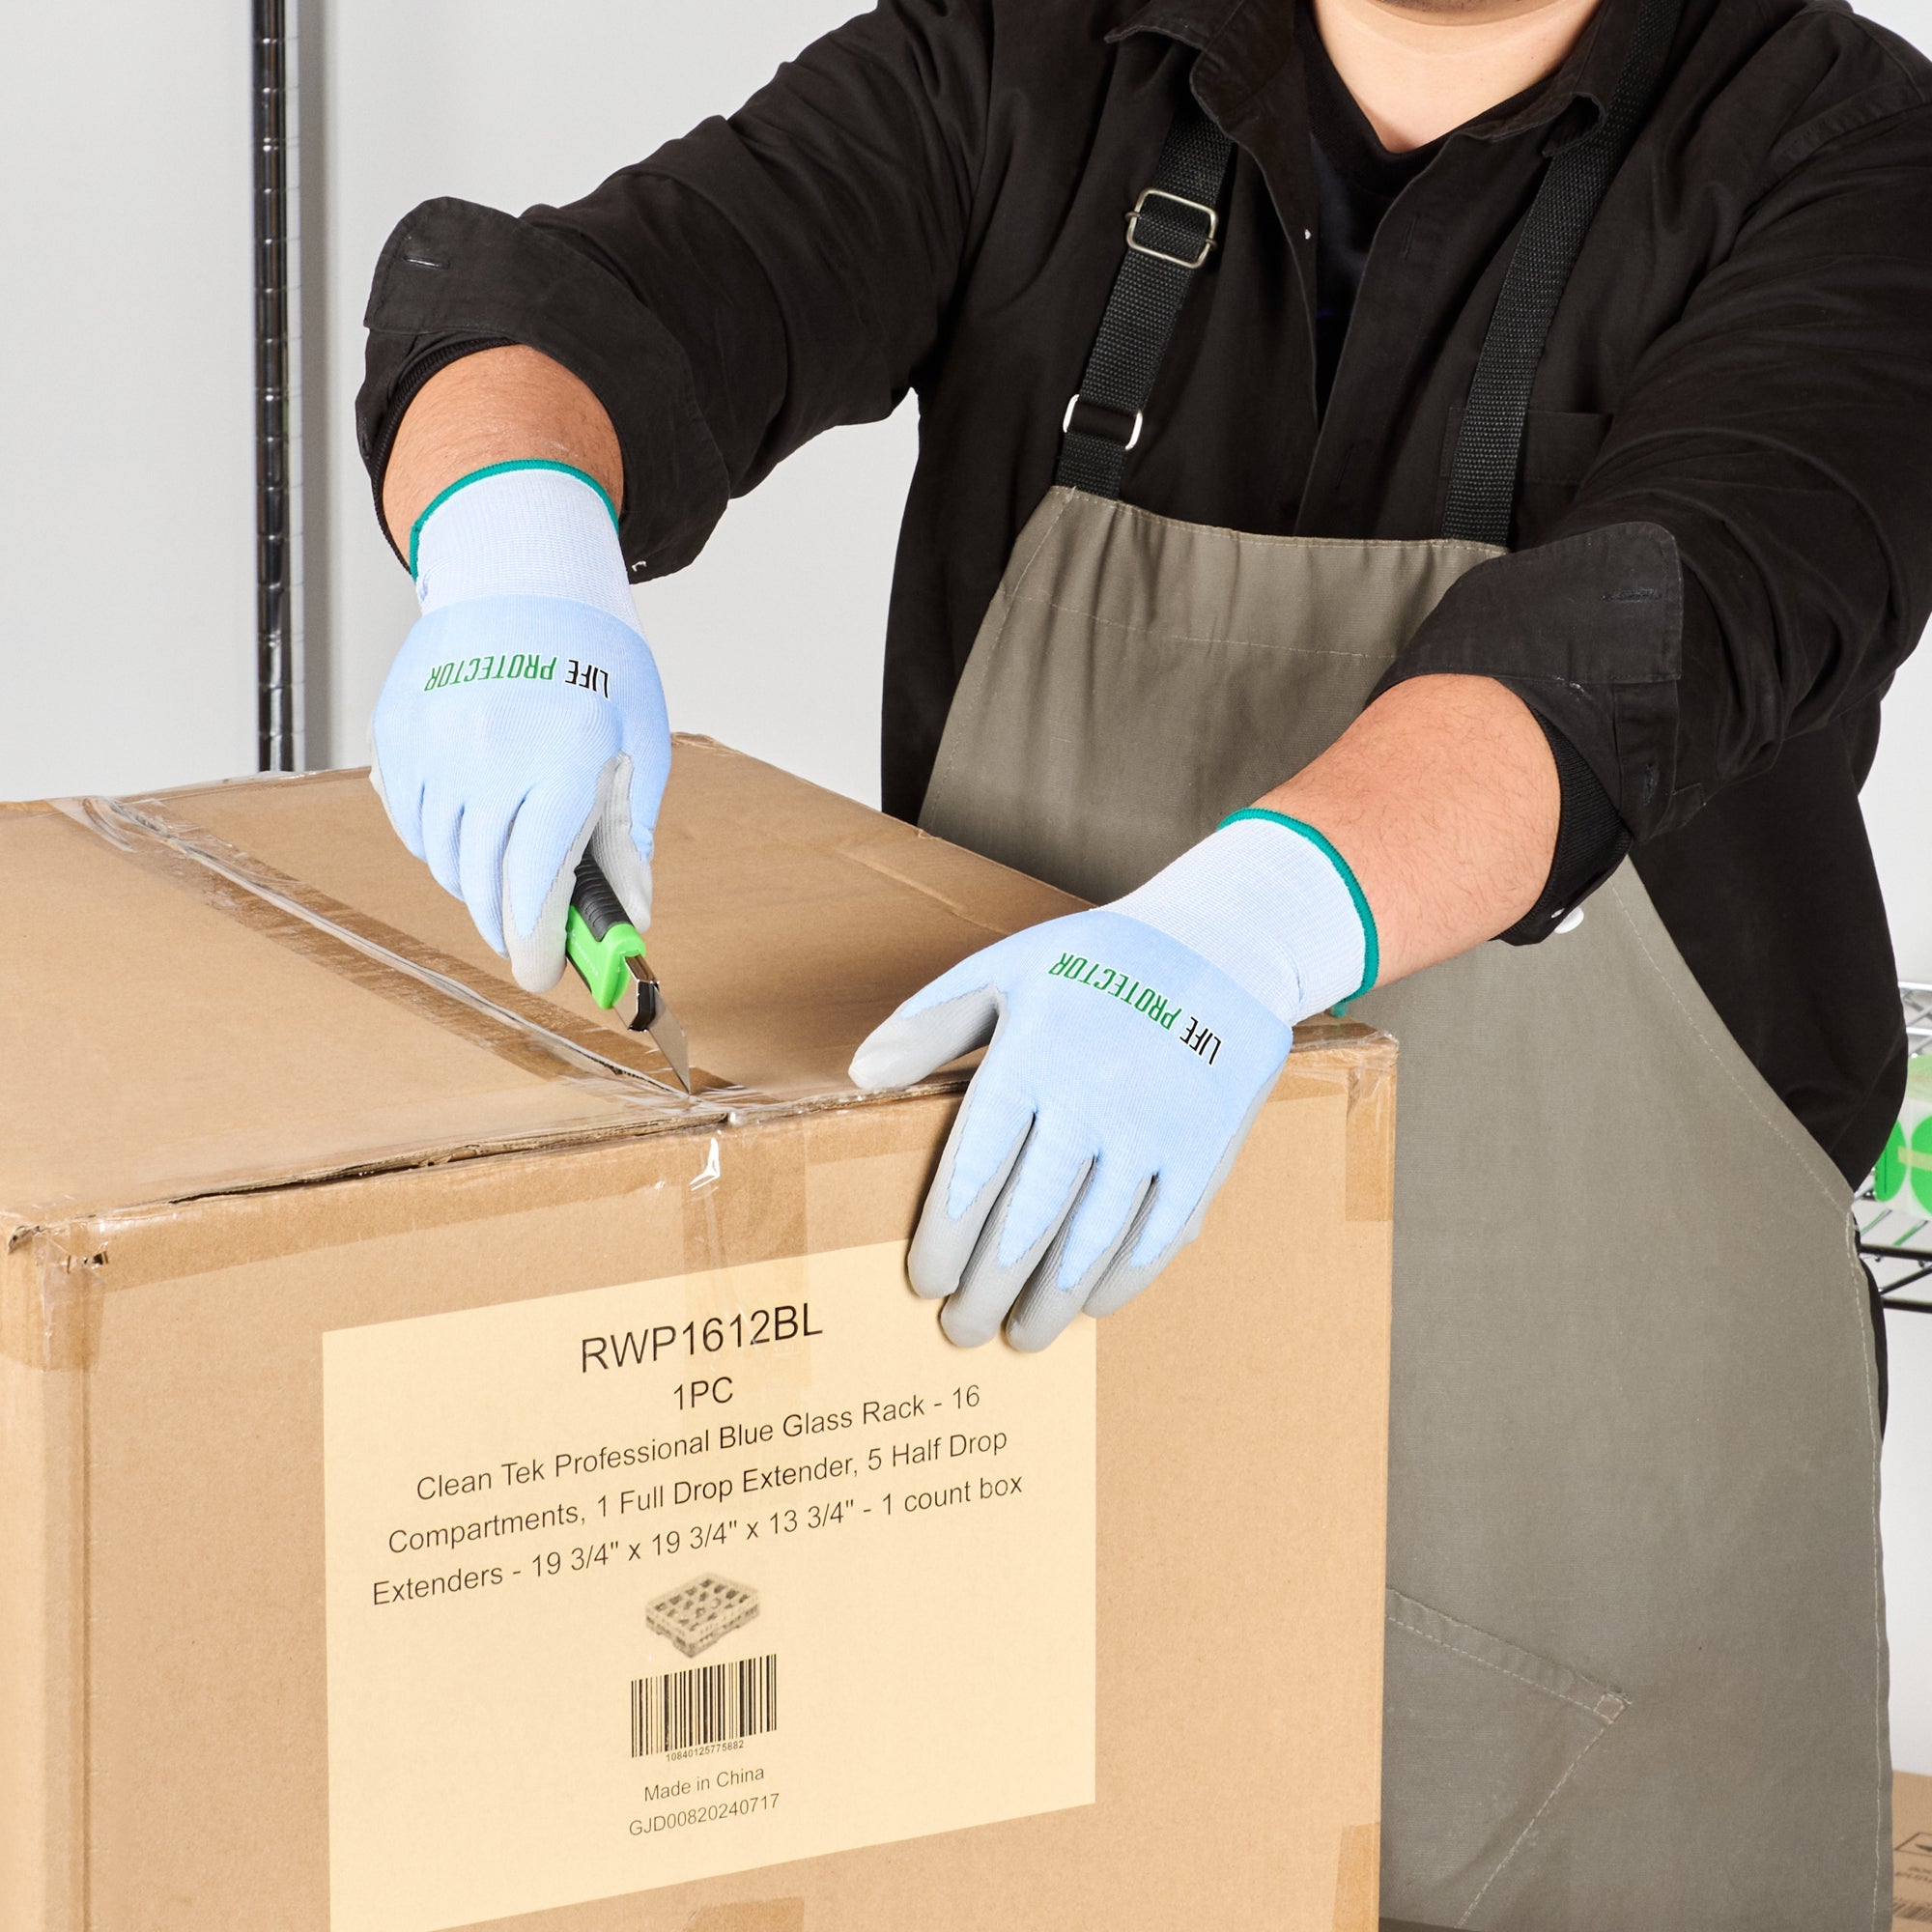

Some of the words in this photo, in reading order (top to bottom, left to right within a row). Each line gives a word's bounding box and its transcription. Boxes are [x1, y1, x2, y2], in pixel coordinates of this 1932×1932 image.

[424, 654, 557, 692] PROTECTOR
[565, 660, 609, 698] LIFE
[1048, 952, 1182, 1030] PROTECTOR
[1179, 1016, 1222, 1065] LIFE
[582, 1303, 823, 1373] RWP1612BL
[673, 1377, 733, 1410] 1PC
[417, 1472, 492, 1500] Clean
[501, 1459, 545, 1486] Tek
[555, 1430, 708, 1477] Professional
[721, 1423, 773, 1449] Blue
[783, 1411, 853, 1437] Glass
[863, 1395, 924, 1425] Rack
[952, 1384, 980, 1409] 16
[389, 1504, 585, 1553] Compartments,
[597, 1495, 606, 1518] 1
[620, 1486, 664, 1515] Full
[674, 1479, 733, 1504] Drop
[743, 1457, 858, 1492] Extender,
[868, 1448, 882, 1470] 5
[893, 1437, 942, 1467] Half
[950, 1432, 1008, 1458] Drop
[373, 1568, 503, 1605] Extenders
[531, 1551, 561, 1577] 19
[571, 1541, 618, 1572] 3/4"
[628, 1543, 641, 1561] x
[651, 1530, 680, 1556] 19
[690, 1520, 737, 1550] 3/4"
[747, 1521, 758, 1540] x
[770, 1510, 798, 1535] 13
[808, 1499, 854, 1529] 3/4"
[882, 1493, 893, 1516] 1
[904, 1481, 971, 1513] count
[980, 1476, 1022, 1501] box
[667, 1740, 744, 1762] 10840125775882
[644, 1780, 692, 1802] Made
[696, 1776, 710, 1792] in
[717, 1768, 765, 1789] China
[629, 1793, 780, 1836] GJD00820240717
